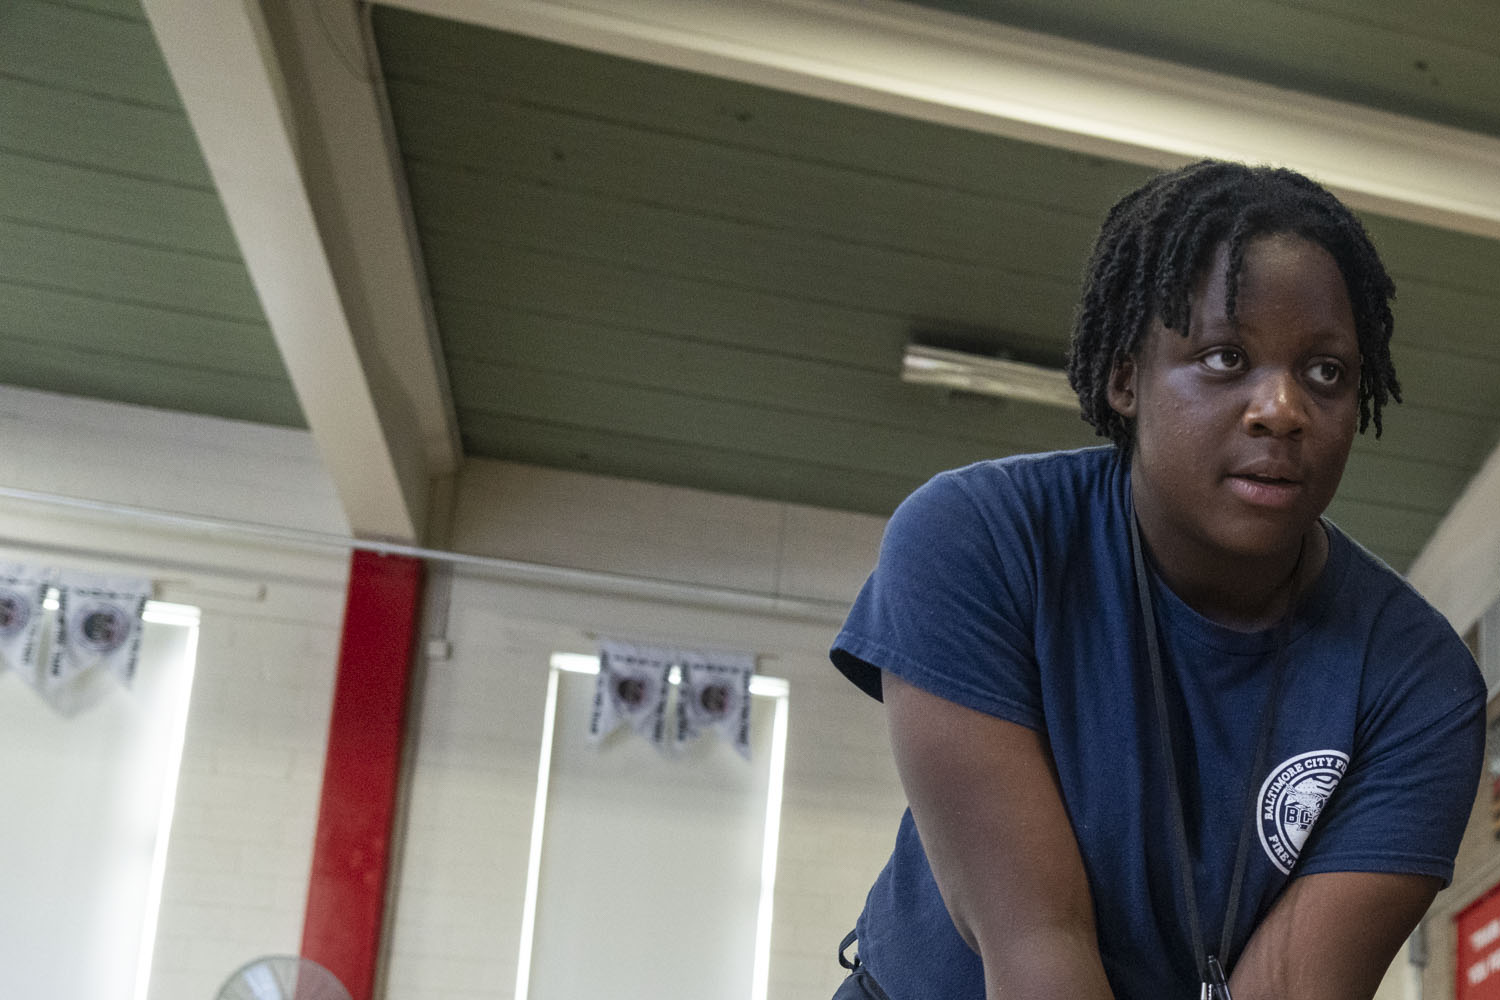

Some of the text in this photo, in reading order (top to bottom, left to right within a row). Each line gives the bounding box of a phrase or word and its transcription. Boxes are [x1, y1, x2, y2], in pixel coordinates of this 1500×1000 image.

[1264, 763, 1304, 820] BALTIMORE
[1304, 757, 1334, 769] CITY
[1268, 834, 1290, 862] FIRE
